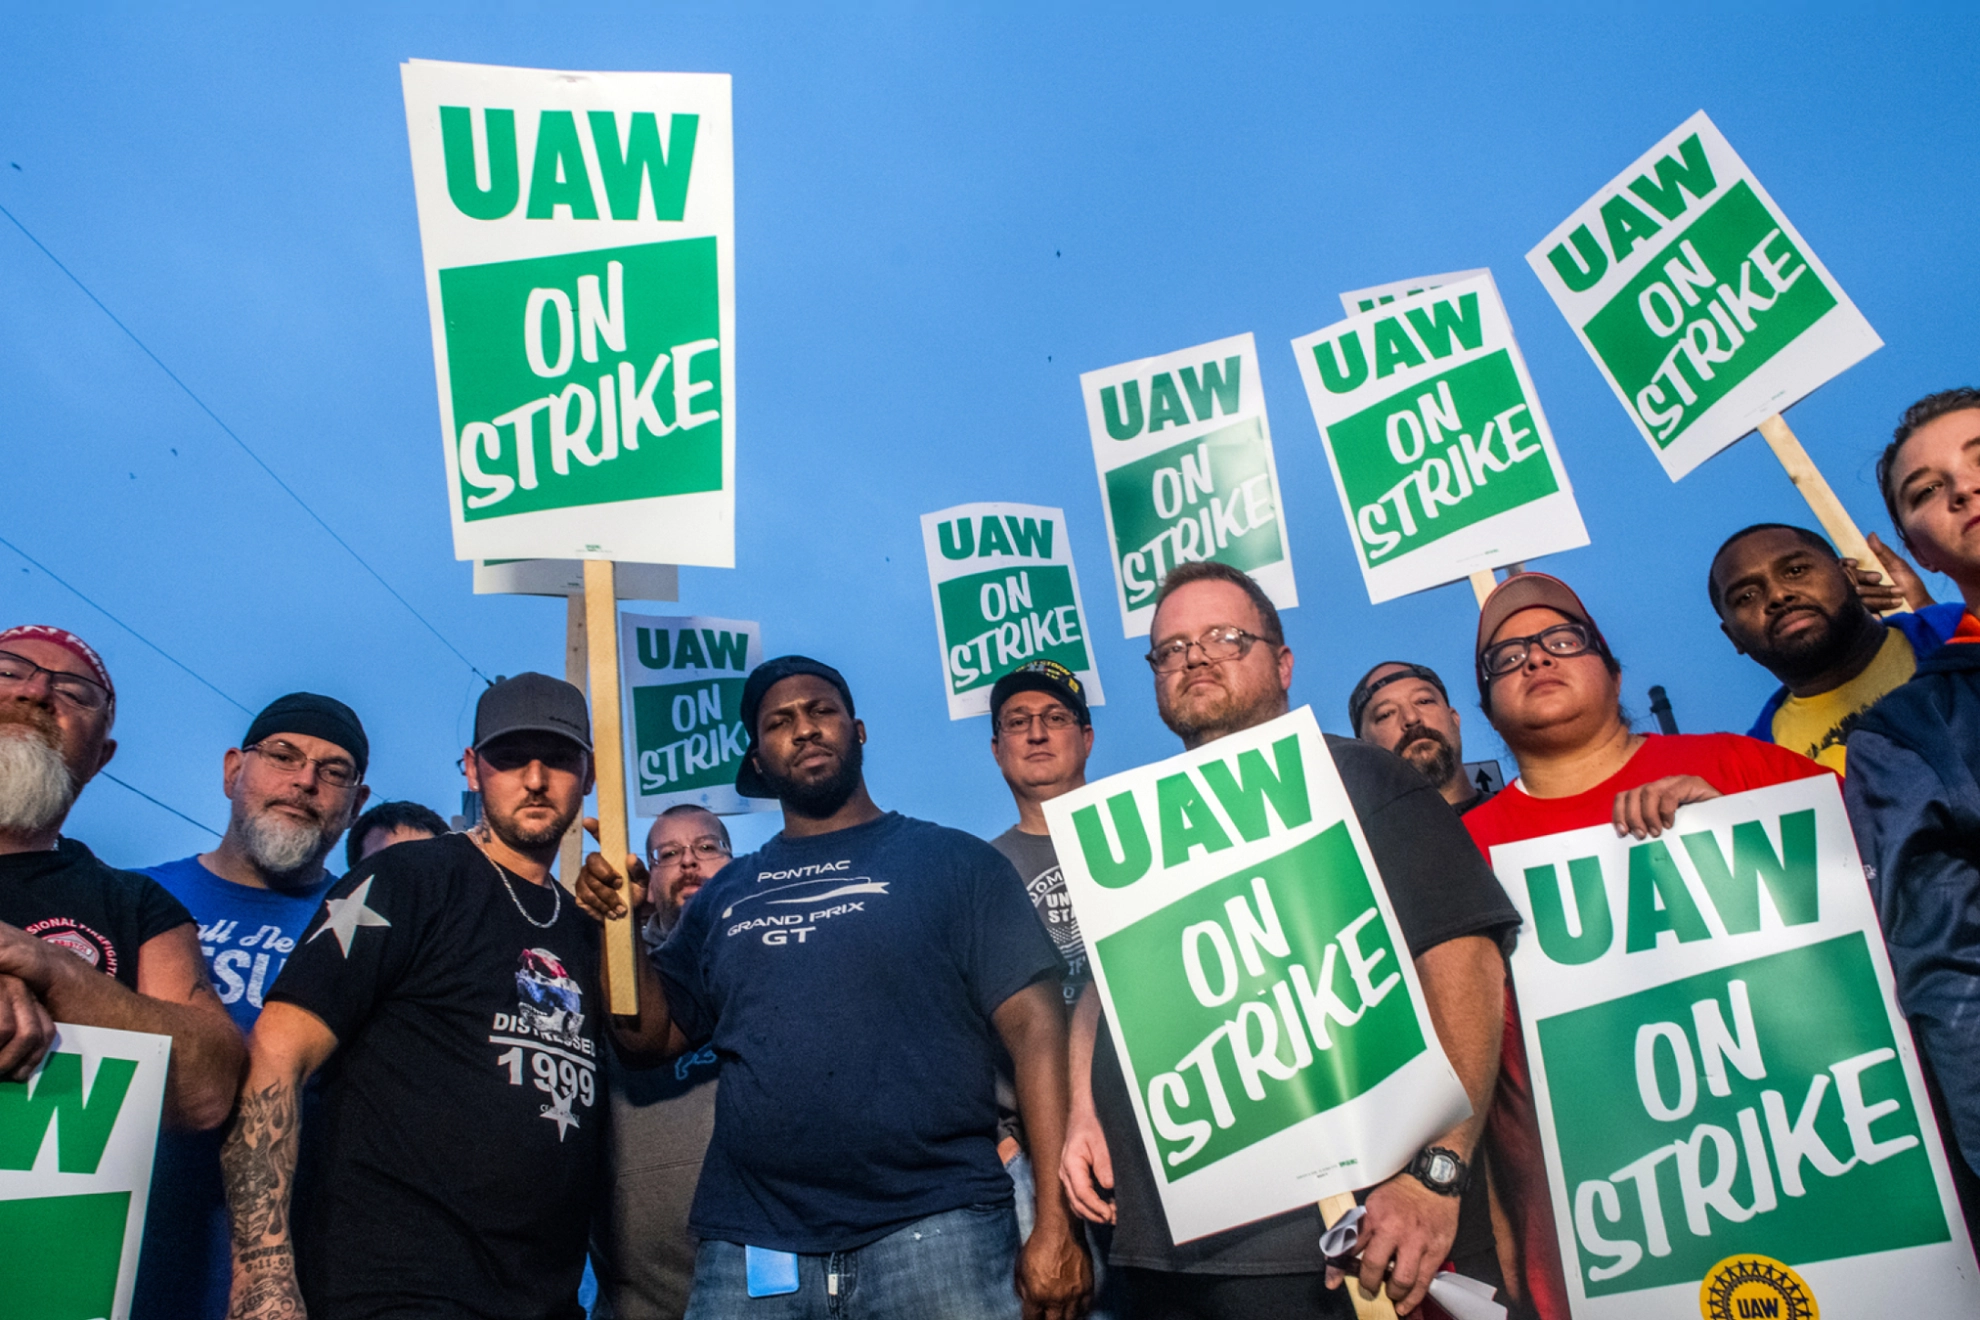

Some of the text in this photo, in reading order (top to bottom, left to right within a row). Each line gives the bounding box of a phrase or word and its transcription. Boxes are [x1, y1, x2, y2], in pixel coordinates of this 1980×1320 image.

[438, 105, 700, 222] UAW
[1546, 131, 1718, 293] UAW
[523, 260, 627, 379] ON
[1636, 228, 1807, 441] STRIKE
[1637, 239, 1717, 338] ON
[1312, 291, 1484, 394] UAW
[459, 338, 721, 510] STRIKE
[1099, 355, 1241, 441] UAW
[1385, 379, 1463, 465] ON
[1152, 443, 1214, 520] ON
[1357, 403, 1542, 560] STRIKE
[937, 515, 1054, 561] UAW
[1122, 473, 1275, 605] STRIKE
[980, 571, 1033, 622] ON
[635, 627, 749, 671] UAW
[950, 605, 1082, 688] STRIKE
[639, 720, 751, 791] STRIK
[671, 683, 723, 733] ON
[1071, 732, 1313, 890] UAW
[727, 901, 865, 937] GRAND PRIX
[757, 860, 852, 883] PONTIAC
[1523, 807, 1820, 966] UAW
[762, 926, 817, 946] GT
[1181, 876, 1292, 1009] ON
[497, 1046, 595, 1108] 1999
[1147, 906, 1402, 1167] STRIKE
[1634, 979, 1767, 1122] ON
[1574, 1046, 1920, 1283] STRIKE
[1736, 1298, 1779, 1319] UAW
